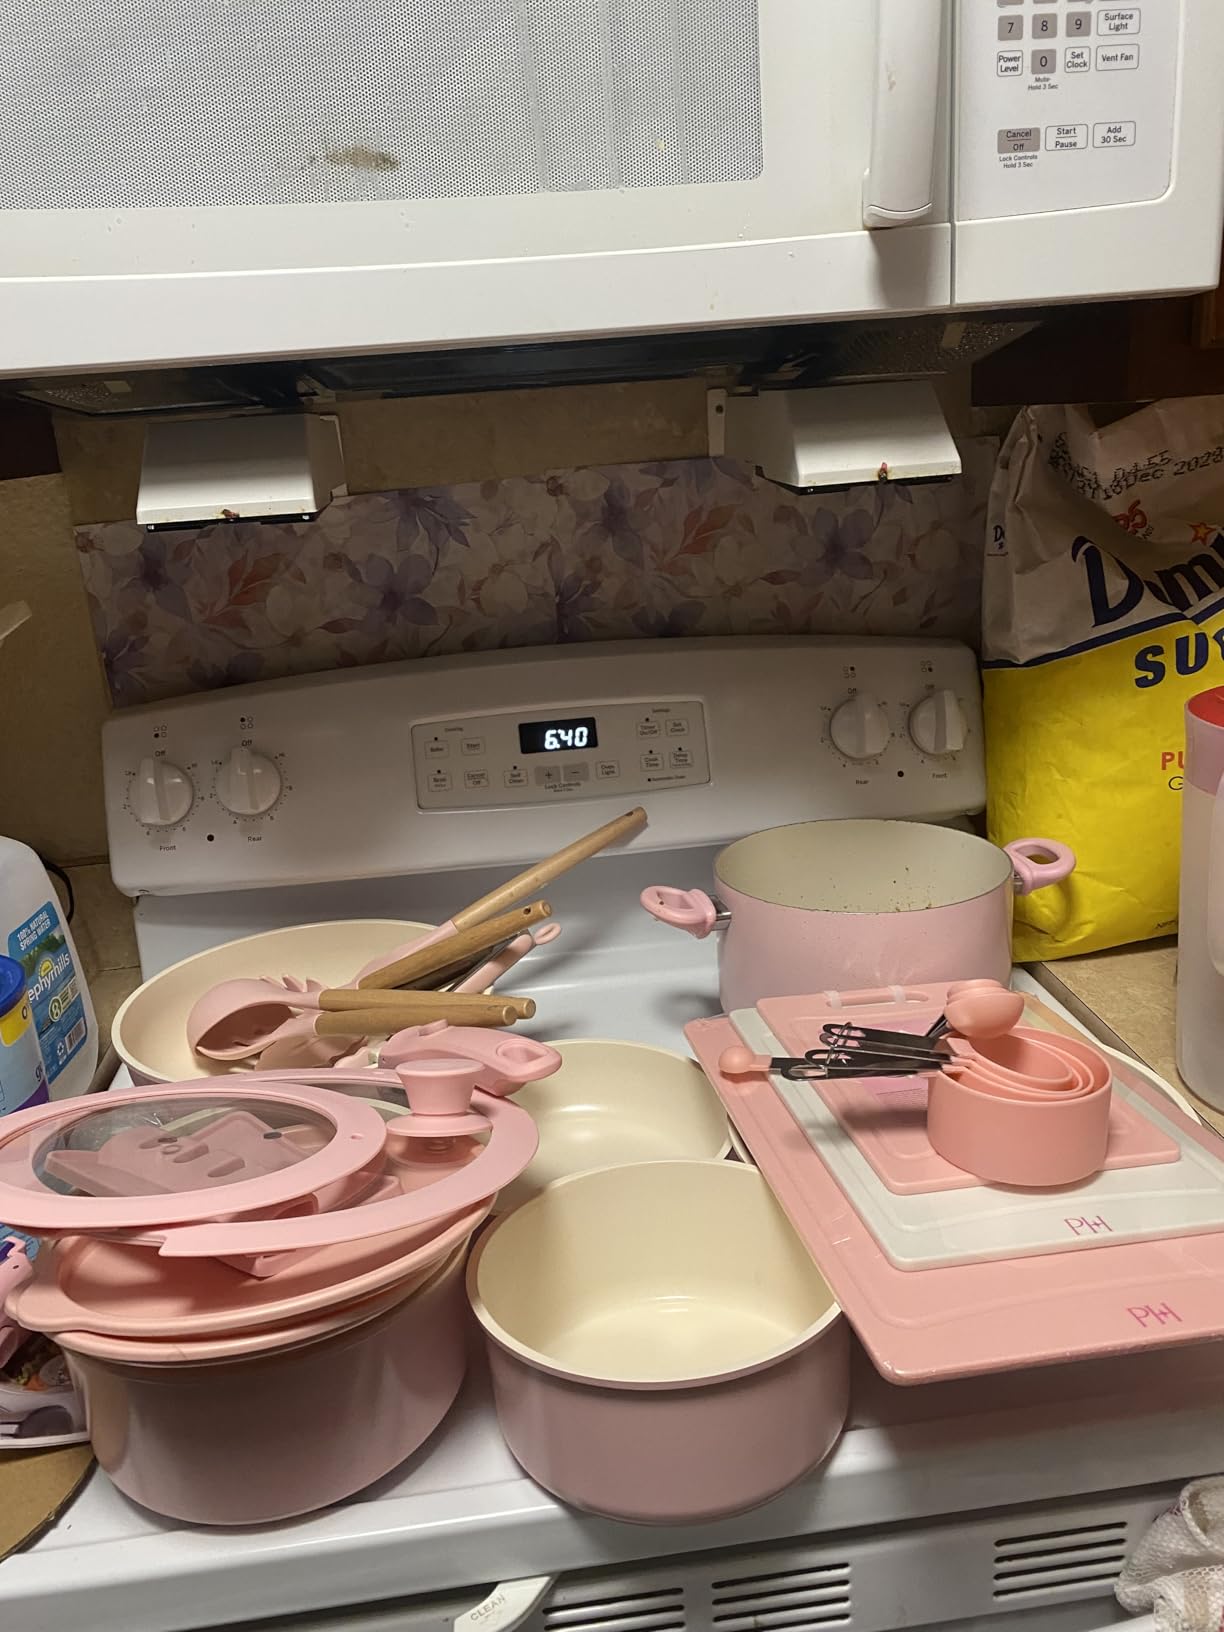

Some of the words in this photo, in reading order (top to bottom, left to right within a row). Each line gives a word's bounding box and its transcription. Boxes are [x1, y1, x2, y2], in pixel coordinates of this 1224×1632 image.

[1104, 12, 1134, 21] Surface
[1007, 21, 1015, 34] 7
[1041, 20, 1049, 32] 8
[1074, 18, 1083, 30] 9
[1108, 22, 1128, 32] Light
[998, 55, 1021, 63] Power
[1071, 51, 1084, 60] Set
[1101, 53, 1119, 62] Vent
[1120, 52, 1134, 61] Fan
[1039, 55, 1048, 68] 0
[1066, 60, 1088, 69] Clock
[1000, 64, 1019, 73] Level
[1006, 129, 1032, 139] Cancel
[1056, 127, 1077, 135] Start
[1107, 125, 1122, 134] Add
[1101, 135, 1112, 144] 30
[1113, 135, 1127, 143] Sec
[1013, 143, 1025, 152] Off
[1055, 140, 1078, 149] Pause
[1172, 446, 1224, 477] 2028
[28, 953, 71, 1001] ephyrhills
[470, 1593, 505, 1621] CLEAN
